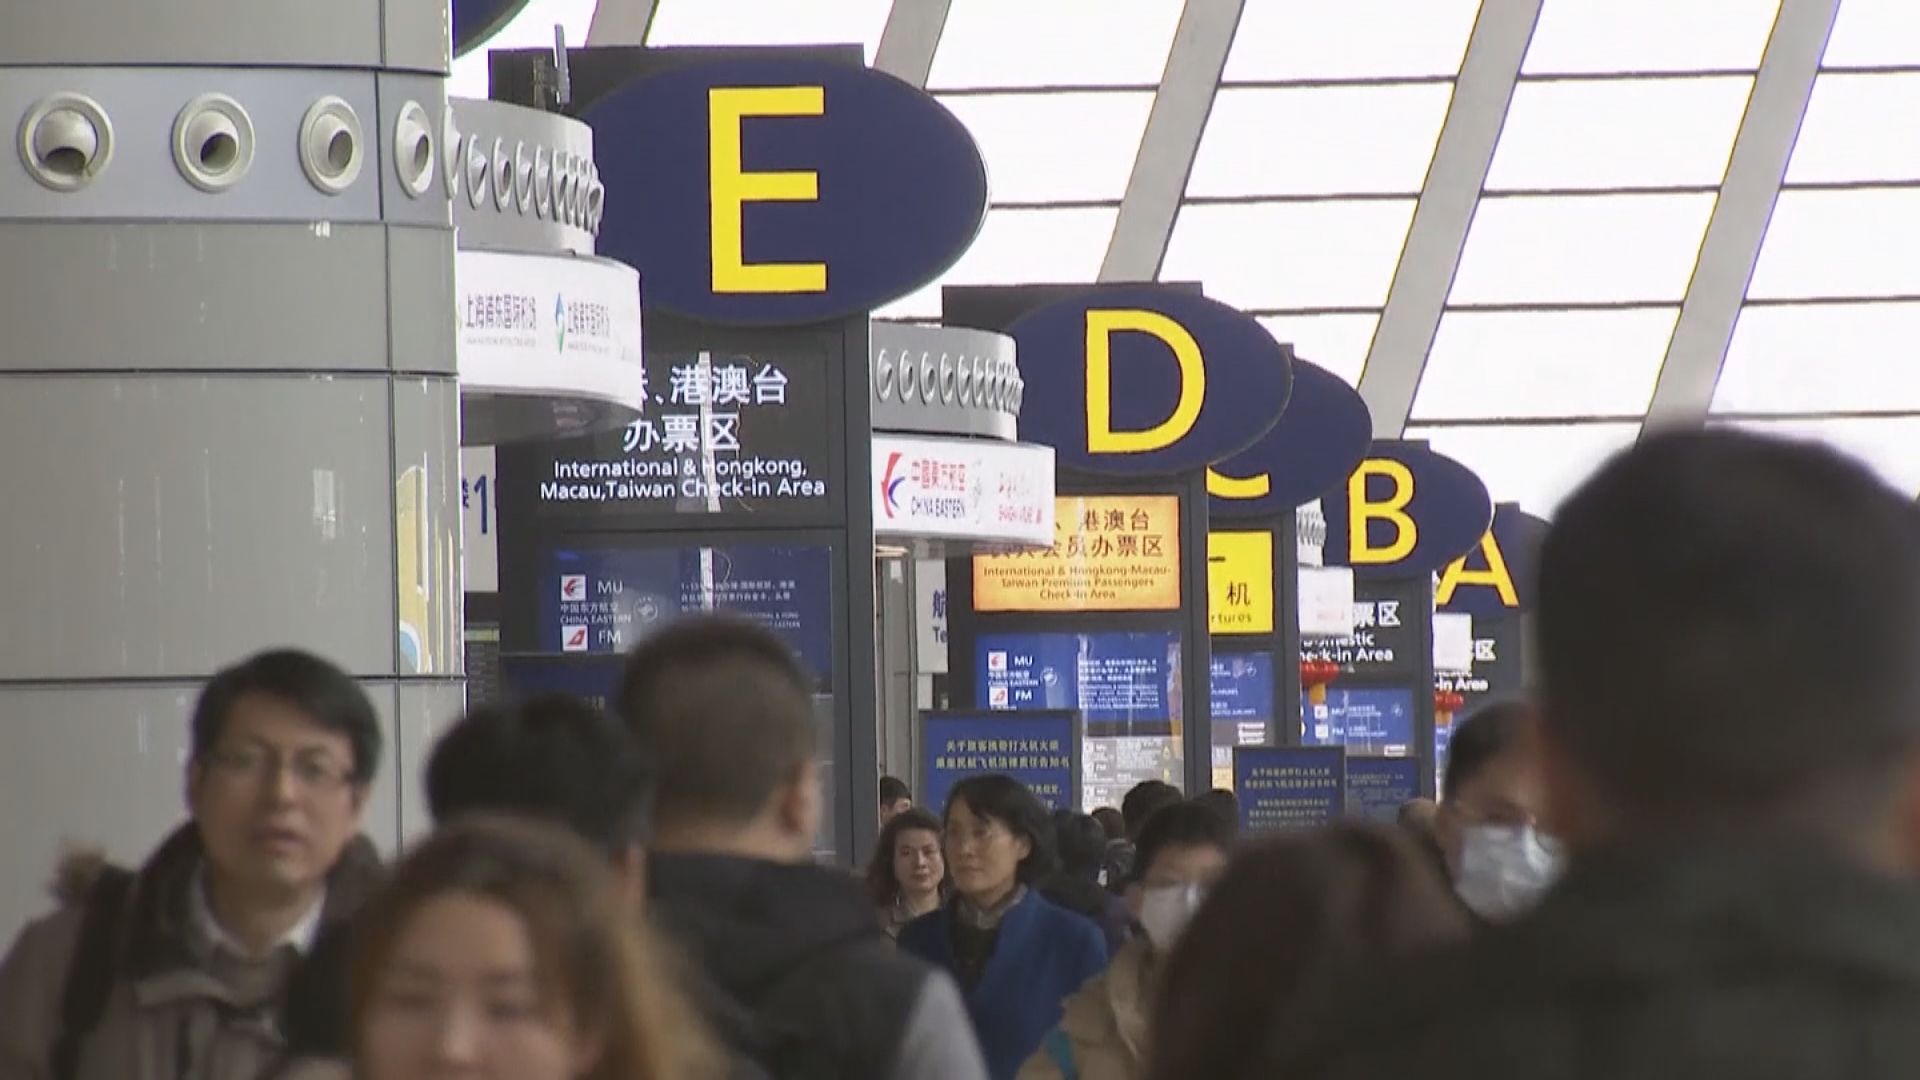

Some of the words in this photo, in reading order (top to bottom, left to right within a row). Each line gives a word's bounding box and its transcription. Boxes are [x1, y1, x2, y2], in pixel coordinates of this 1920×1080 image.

[708, 85, 828, 294] E
[641, 365, 789, 405] 、港澳台
[1084, 308, 1206, 454] D
[623, 413, 741, 453] 办票区
[554, 458, 678, 479] International
[682, 460, 697, 478] &
[703, 457, 808, 479] Hongkong,
[777, 479, 826, 498] Area
[1348, 457, 1418, 565] B
[983, 565, 1055, 577] International
[1058, 566, 1066, 576] &
[1435, 528, 1520, 607] A
[598, 579, 623, 594] MU
[1001, 577, 1038, 588] Taiwan
[1041, 577, 1091, 588] Premium
[1094, 577, 1154, 589] Passengers
[1091, 589, 1116, 599] Area
[560, 614, 589, 624] CHINA
[591, 613, 631, 625] EASTERN
[598, 629, 621, 644] FM
[1014, 654, 1033, 668] MU
[1356, 647, 1394, 662] Area
[1455, 678, 1489, 692] Area
[1015, 689, 1033, 701] FM
